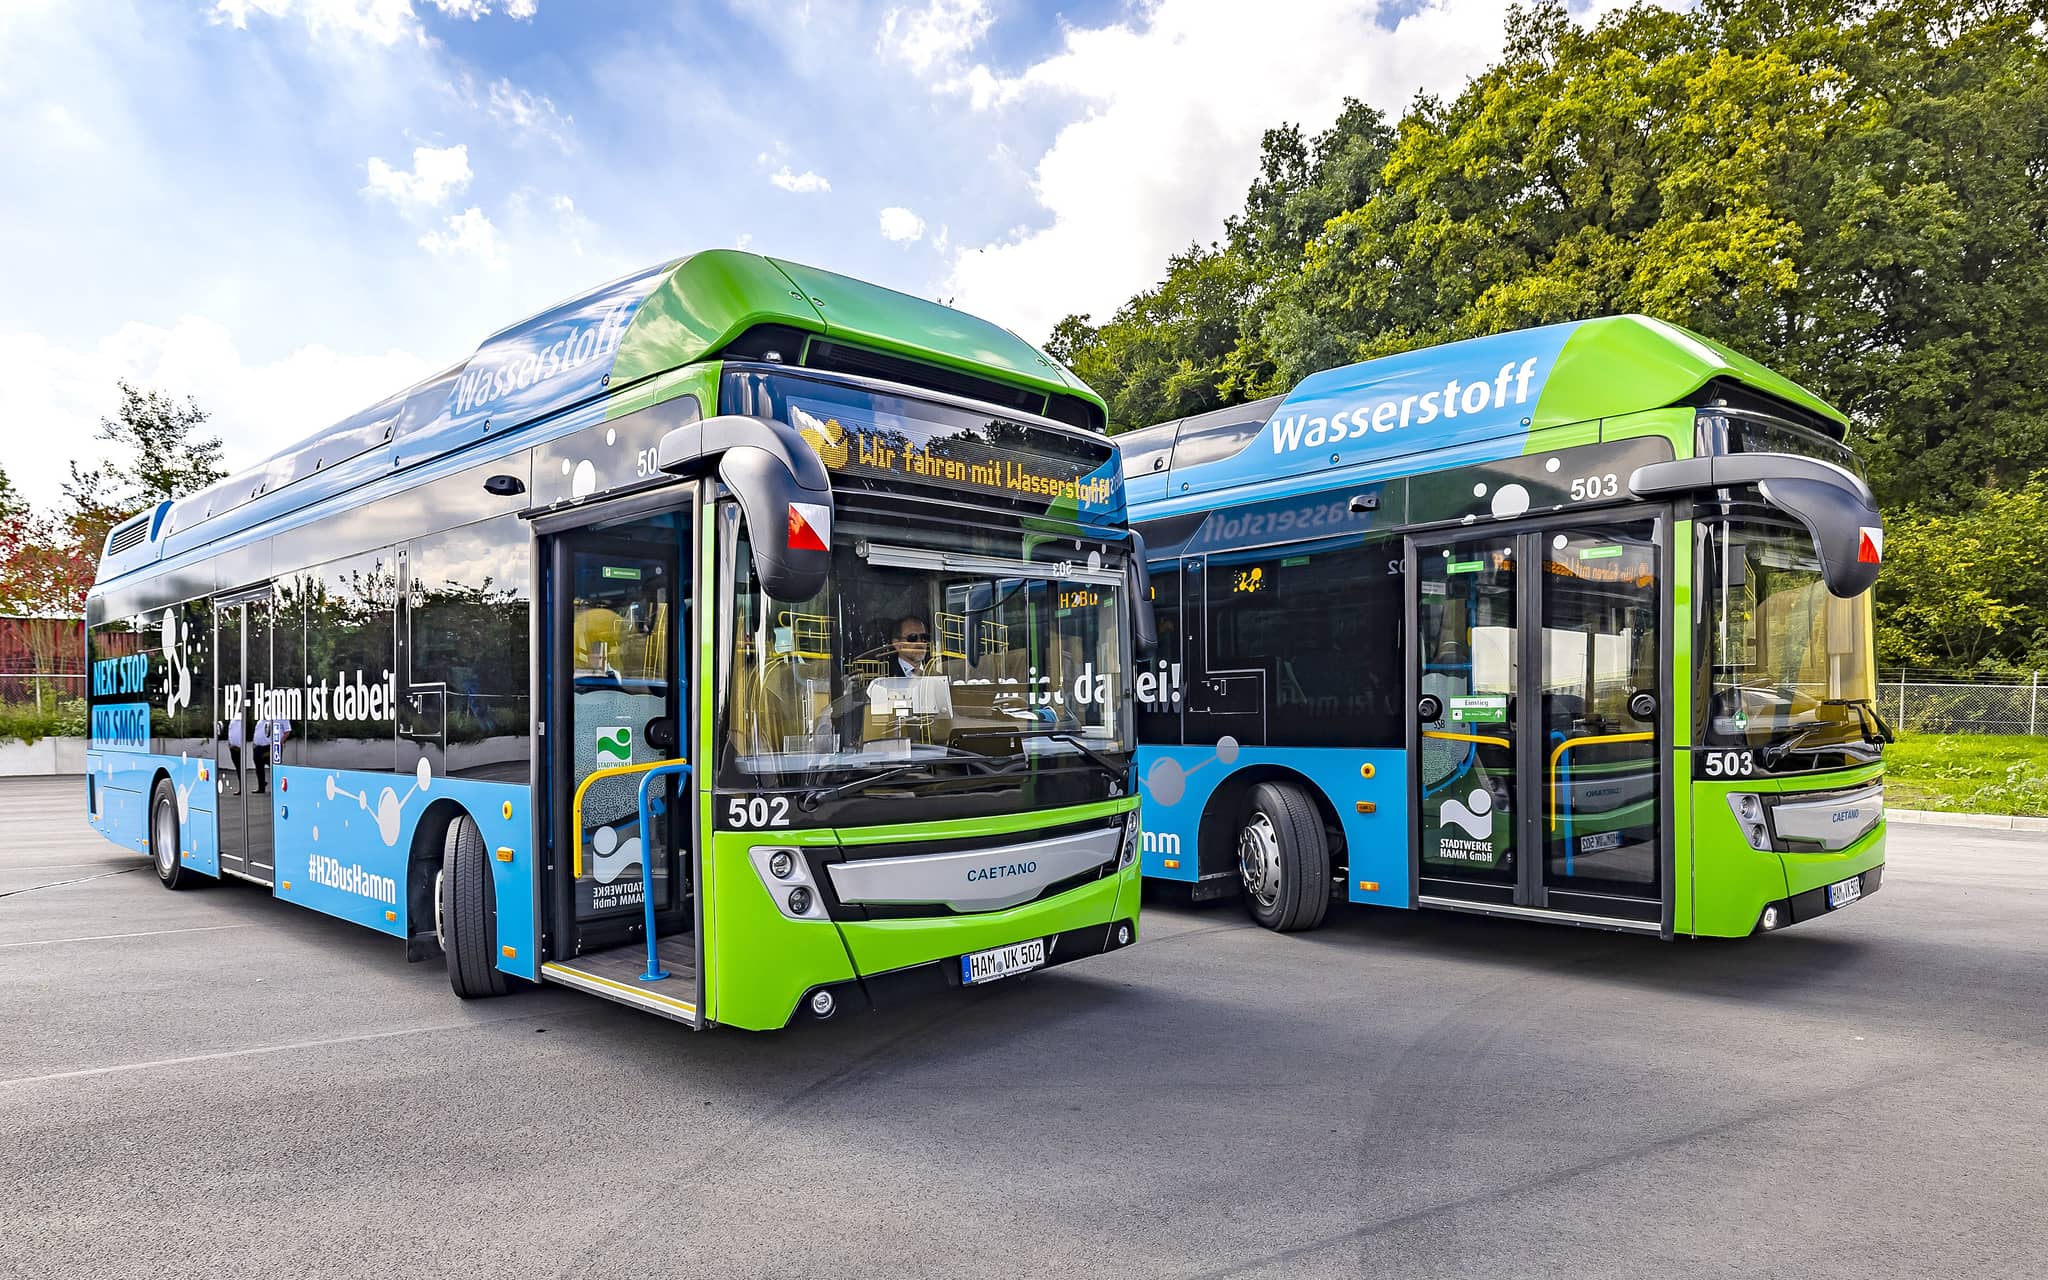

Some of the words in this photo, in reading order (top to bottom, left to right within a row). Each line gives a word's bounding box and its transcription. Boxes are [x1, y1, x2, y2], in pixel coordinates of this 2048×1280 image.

[454, 303, 627, 415] Wasserstoff
[1271, 357, 1538, 455] Wasserstoff
[637, 447, 661, 477] 50
[858, 433, 896, 468] Wir
[902, 441, 966, 481] fahren
[971, 460, 1002, 487] mit
[1006, 461, 1109, 505] Wasserstoff!
[1570, 473, 1619, 501] 503
[93, 657, 118, 696] NEXT
[119, 653, 148, 693] STOP
[307, 674, 328, 720] ist
[333, 669, 396, 721] dabei!
[95, 710, 110, 745] NO
[113, 709, 145, 747] SMOG
[1705, 752, 1753, 776] 503
[728, 797, 790, 827] 502
[1833, 808, 1859, 823] CAETANO
[1440, 838, 1493, 851] STADTWERKE
[1440, 848, 1467, 860] HAMM
[1469, 851, 1493, 862] GmbH
[308, 854, 396, 904] #H2BusHamm
[967, 861, 1037, 882] CAETANO
[971, 954, 996, 978] HAM
[1003, 948, 1019, 970] VK
[1021, 943, 1042, 965] 502
